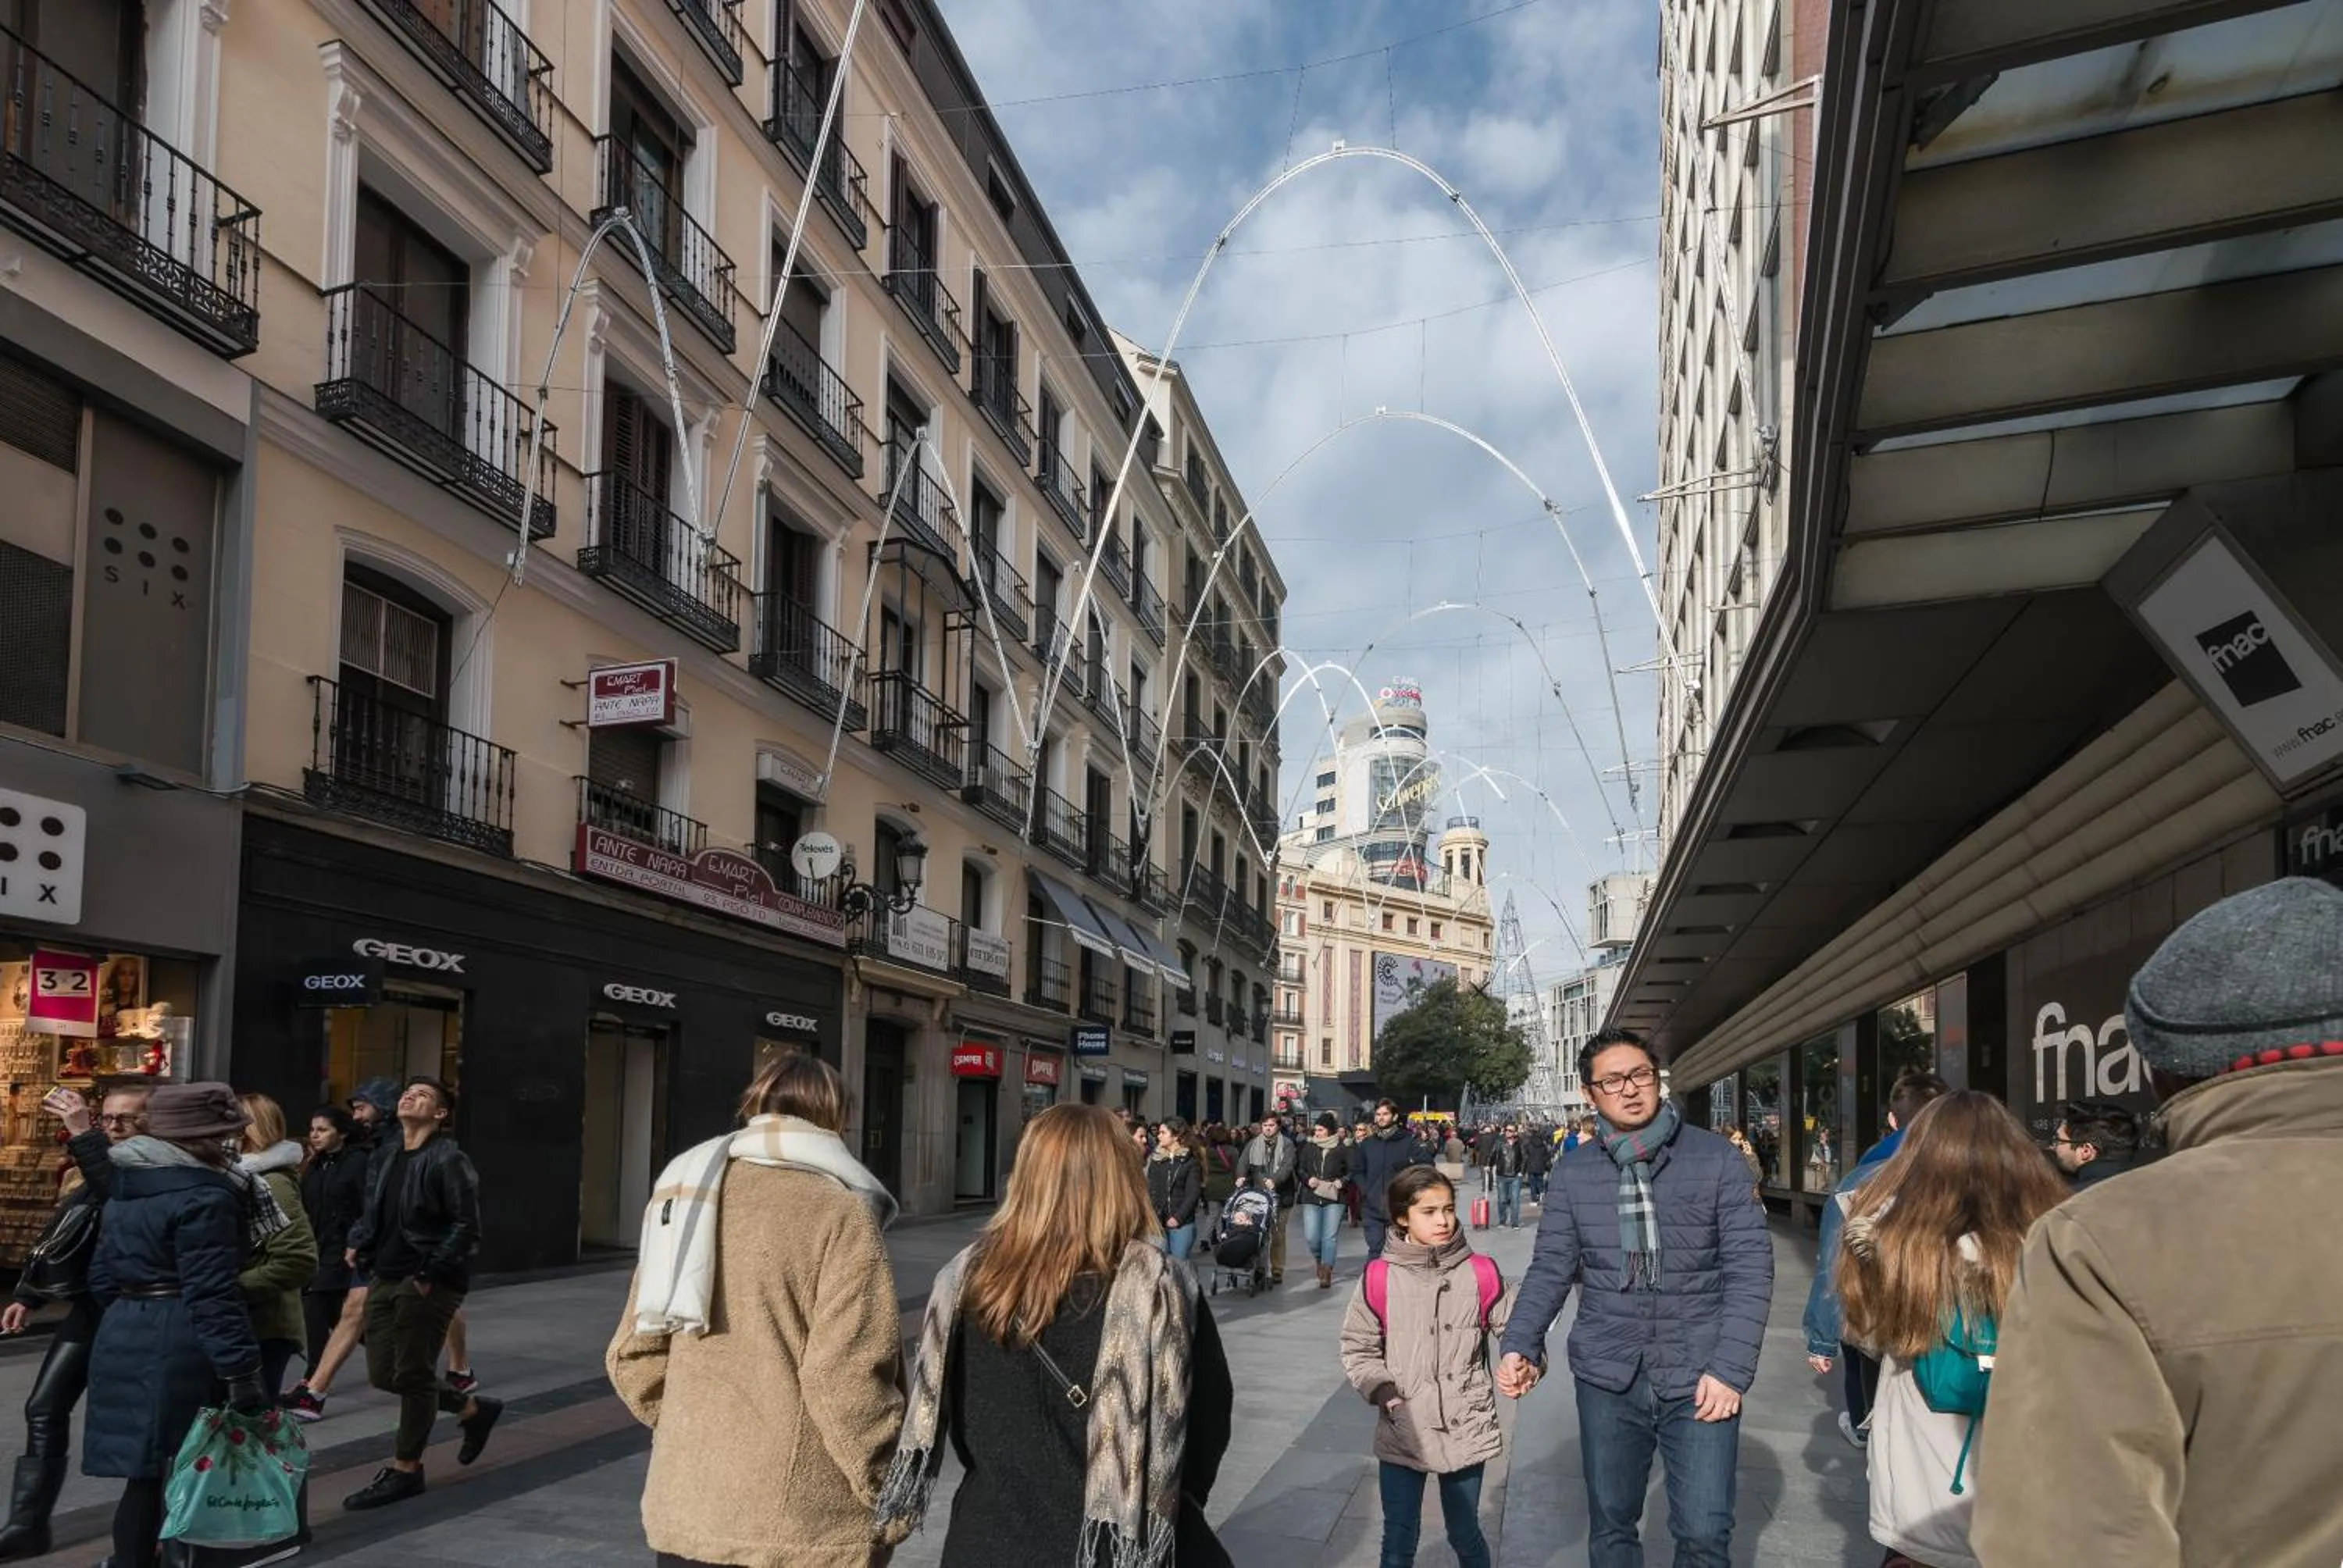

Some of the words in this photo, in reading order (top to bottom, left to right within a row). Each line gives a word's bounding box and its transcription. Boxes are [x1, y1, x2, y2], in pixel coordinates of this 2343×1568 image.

[105, 565, 186, 610] SIX
[2207, 622, 2270, 673] fnac
[2273, 708, 2343, 761] www.fnac.e
[594, 836, 638, 864] ANTE
[647, 852, 688, 878] NAPA
[352, 938, 465, 974] GEOX
[304, 975, 366, 990] GEOX
[603, 983, 676, 1009] GEOX
[765, 1012, 818, 1032] GEOX
[2032, 1002, 2153, 1103] fna
